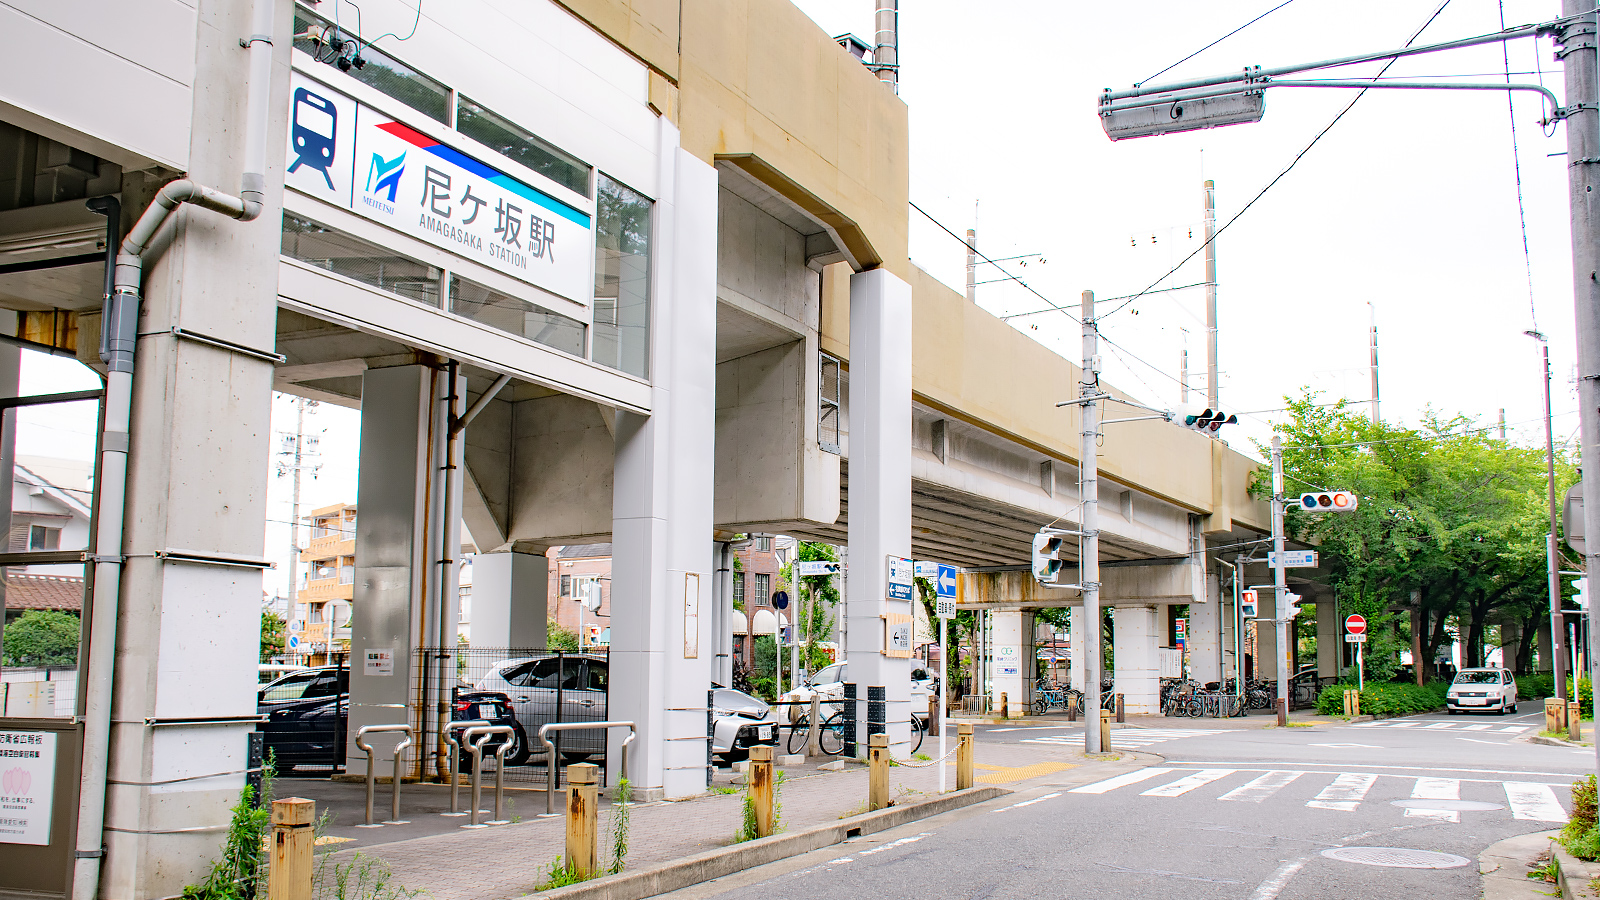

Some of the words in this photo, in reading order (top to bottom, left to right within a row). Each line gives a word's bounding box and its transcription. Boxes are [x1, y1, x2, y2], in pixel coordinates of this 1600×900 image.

[362, 195, 395, 215] MEITETSU
[419, 213, 483, 252] AMAGASAKA
[489, 243, 527, 270] STATION
